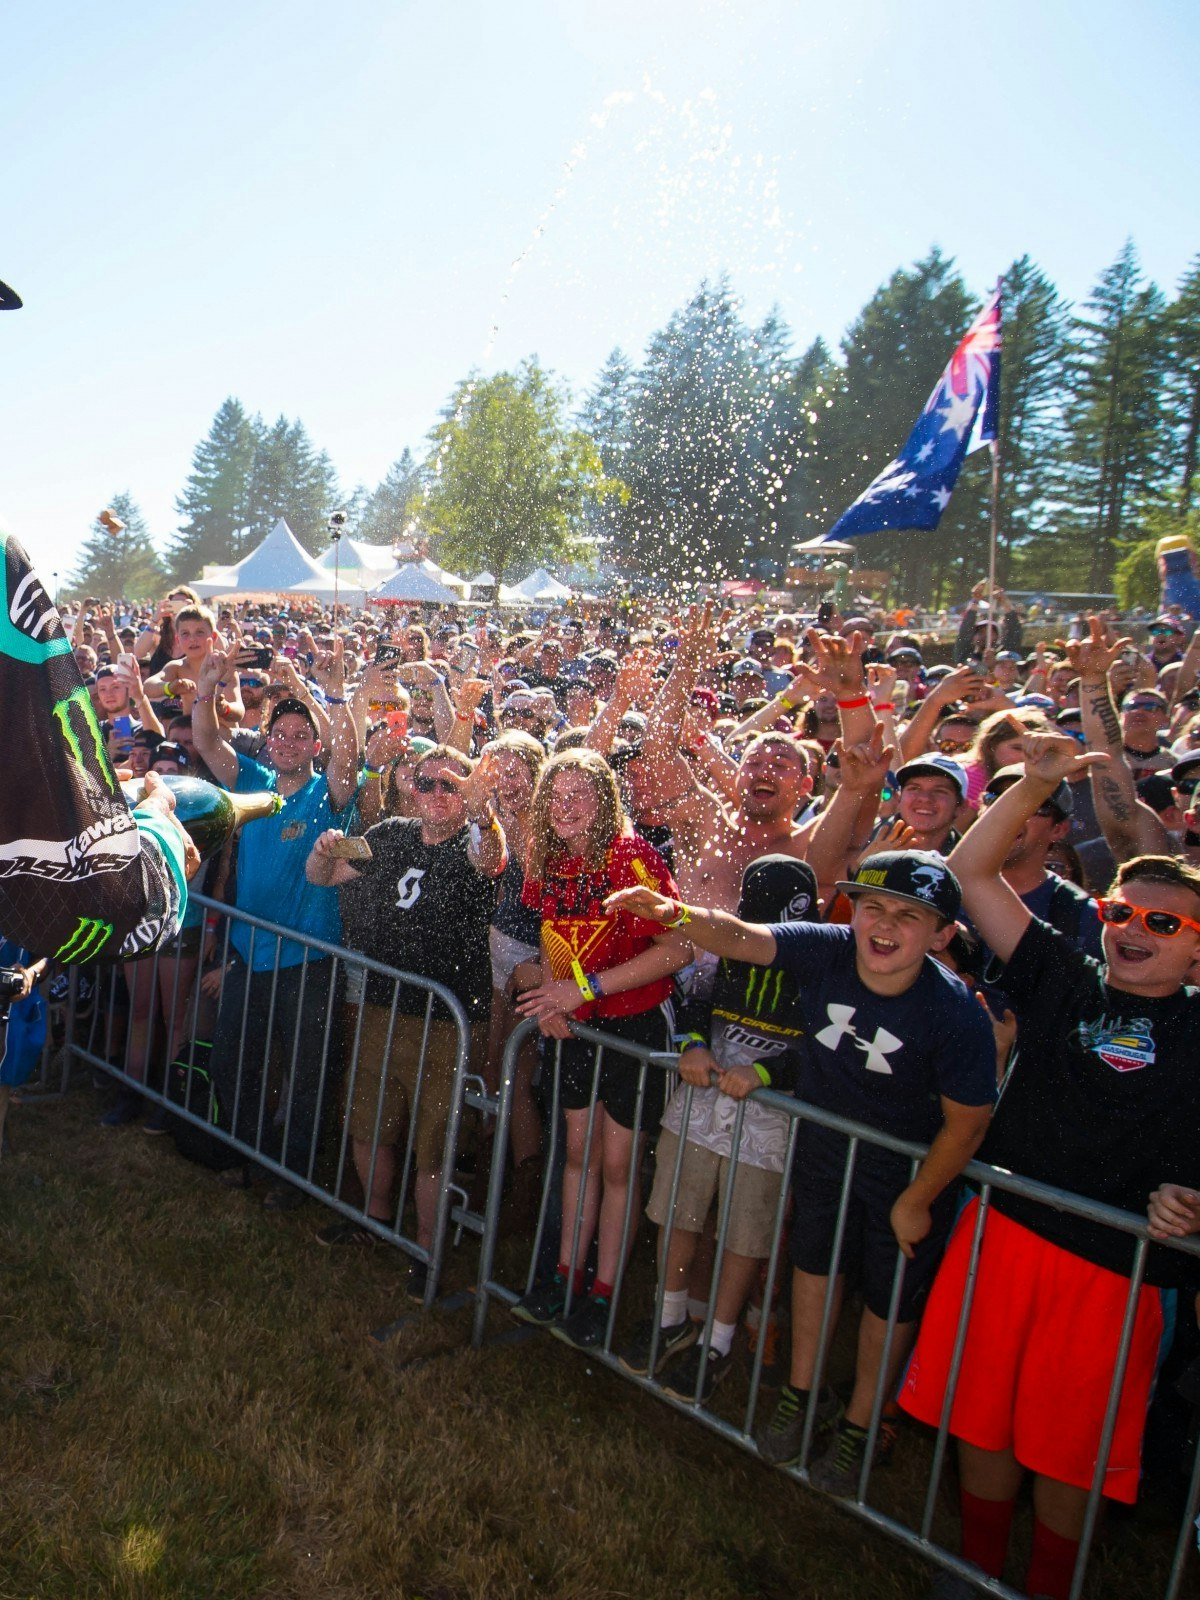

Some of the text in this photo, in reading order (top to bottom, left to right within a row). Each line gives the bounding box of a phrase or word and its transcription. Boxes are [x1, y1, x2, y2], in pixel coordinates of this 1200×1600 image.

[712, 1008, 804, 1037] PRO CIRCUIT
[721, 1023, 788, 1053] thor
